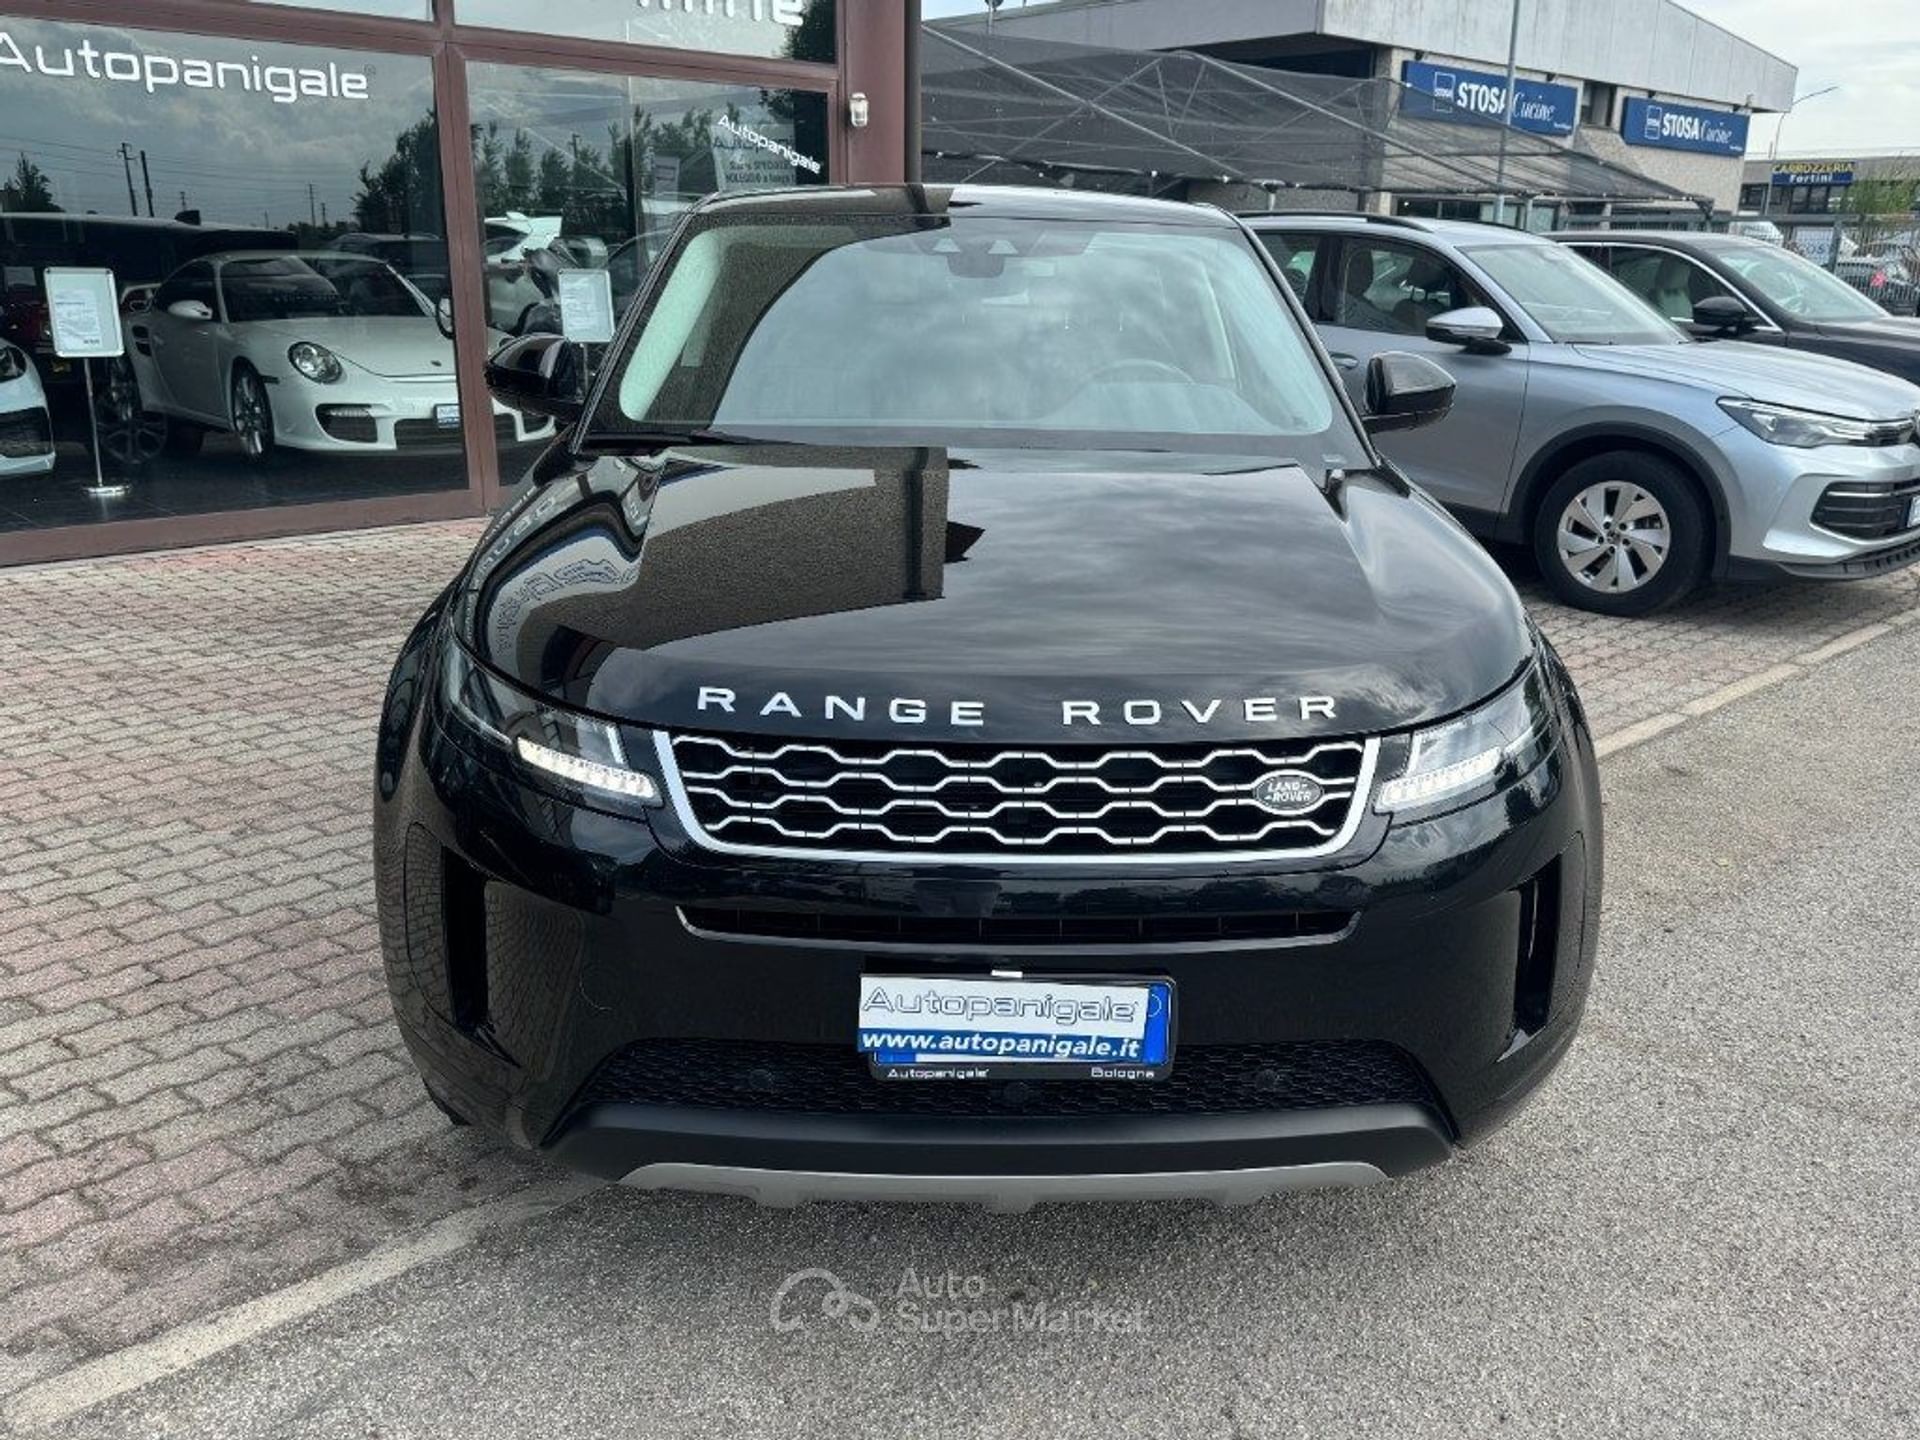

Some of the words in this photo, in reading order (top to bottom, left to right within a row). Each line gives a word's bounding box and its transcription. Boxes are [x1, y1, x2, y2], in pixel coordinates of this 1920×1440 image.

[0, 31, 369, 103] Autopanigale
[718, 114, 821, 174] Autopanigale
[1661, 112, 1699, 140] STOSA
[697, 686, 985, 727] RANGE
[1063, 695, 1337, 726] ROVER
[862, 986, 1135, 1025] Autopanigale
[861, 1029, 1140, 1058] www.autopanigale.it
[887, 1068, 987, 1080] Autopanigale
[1090, 1066, 1155, 1080] Bologna
